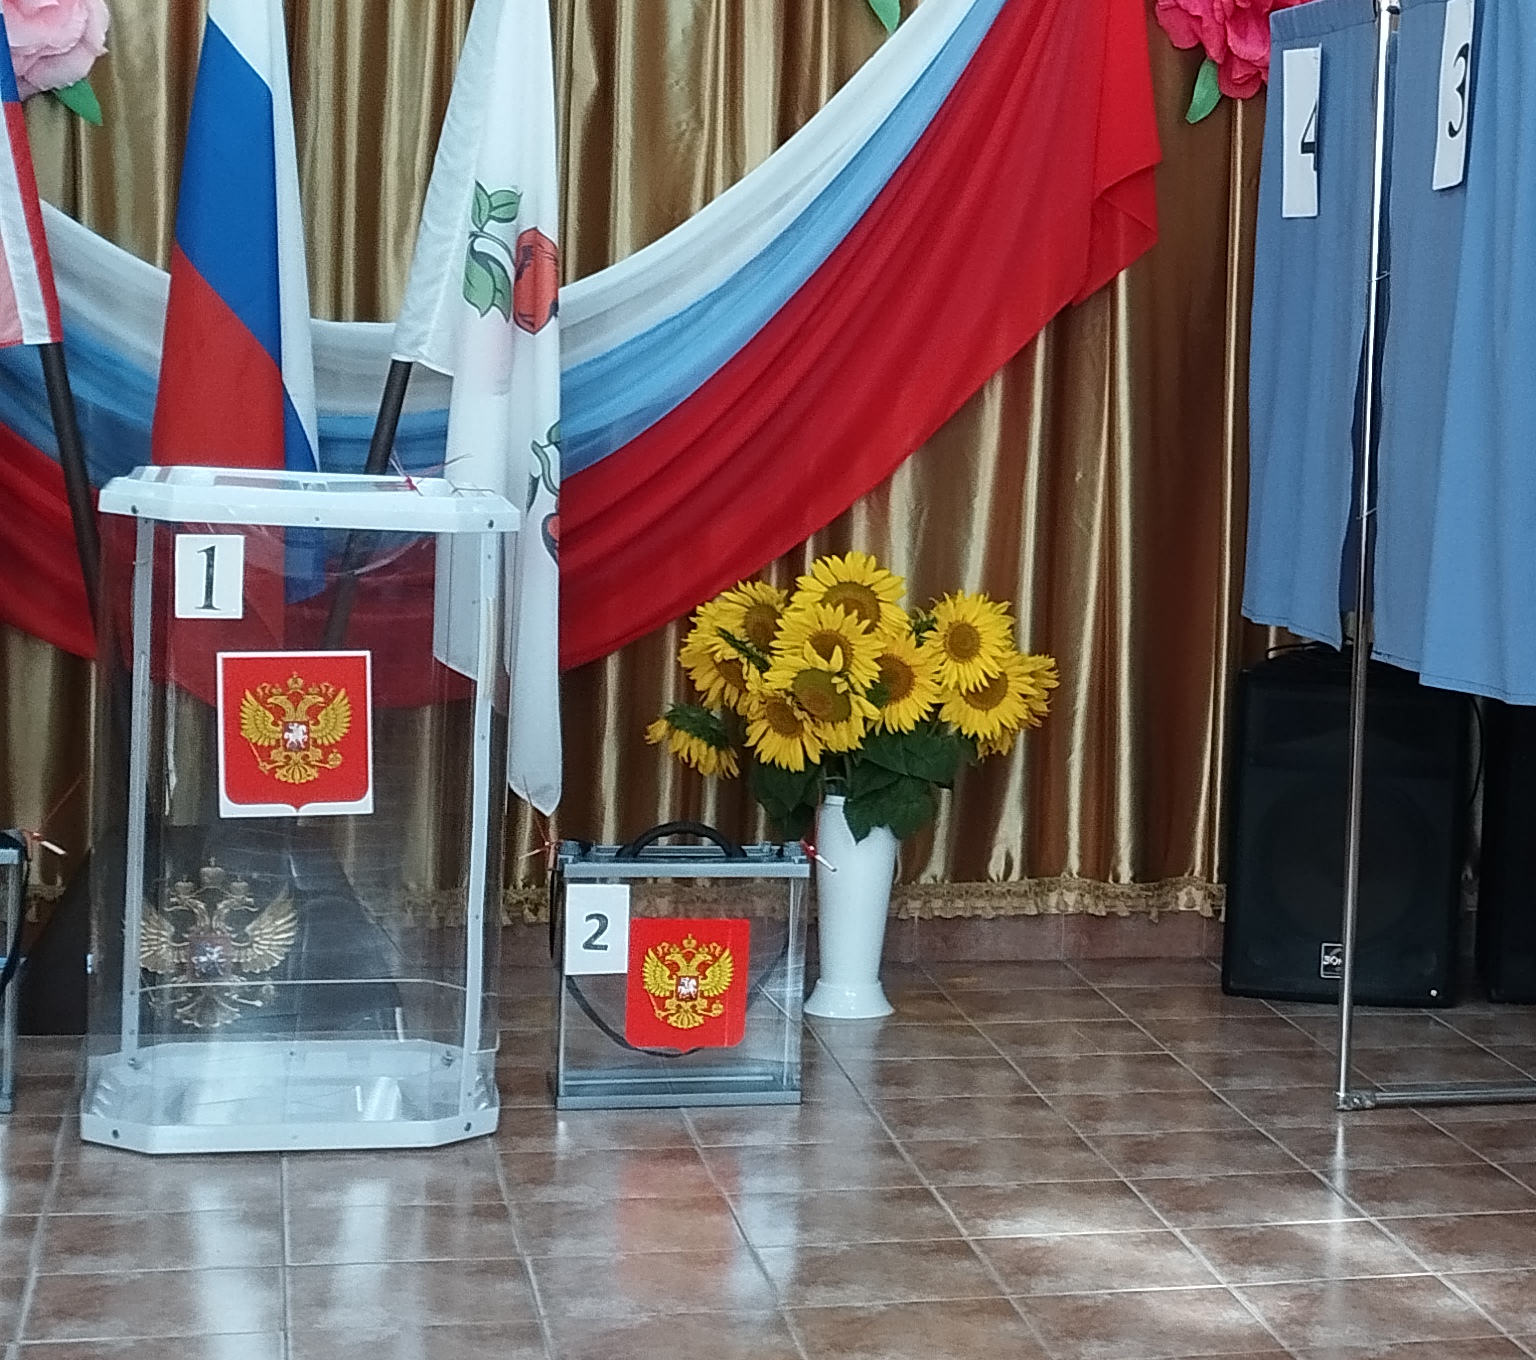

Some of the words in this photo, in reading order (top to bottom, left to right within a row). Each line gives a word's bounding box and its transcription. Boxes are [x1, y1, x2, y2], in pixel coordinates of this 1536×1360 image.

[1447, 42, 1470, 138] 3
[194, 544, 221, 611] 1
[582, 912, 609, 951] 2
